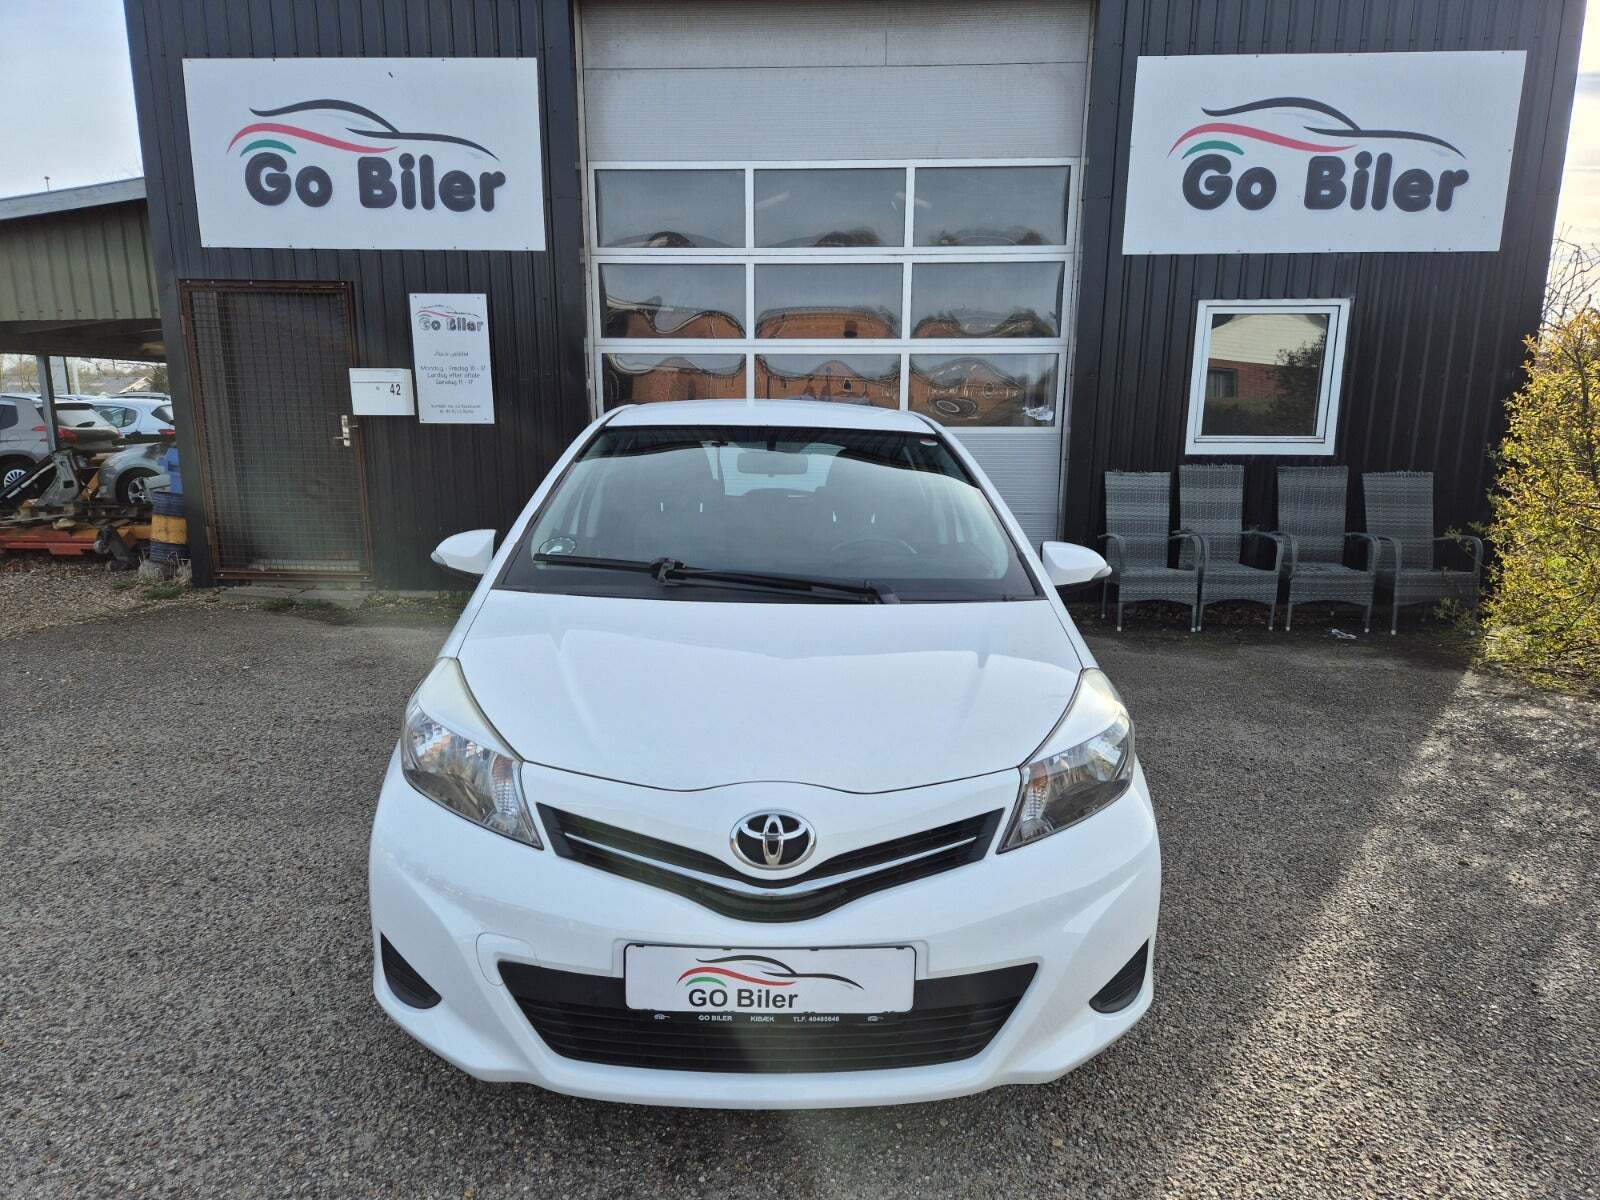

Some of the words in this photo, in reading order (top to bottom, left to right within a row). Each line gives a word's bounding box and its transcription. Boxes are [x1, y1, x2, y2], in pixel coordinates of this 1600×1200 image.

[245, 152, 333, 207] Go
[357, 152, 506, 212] Biler
[1182, 153, 1277, 210] Go
[1304, 151, 1469, 212] Biler
[419, 317, 441, 331] Go
[390, 383, 401, 396] 42
[688, 988, 728, 1007] GO
[737, 988, 799, 1009] Biler
